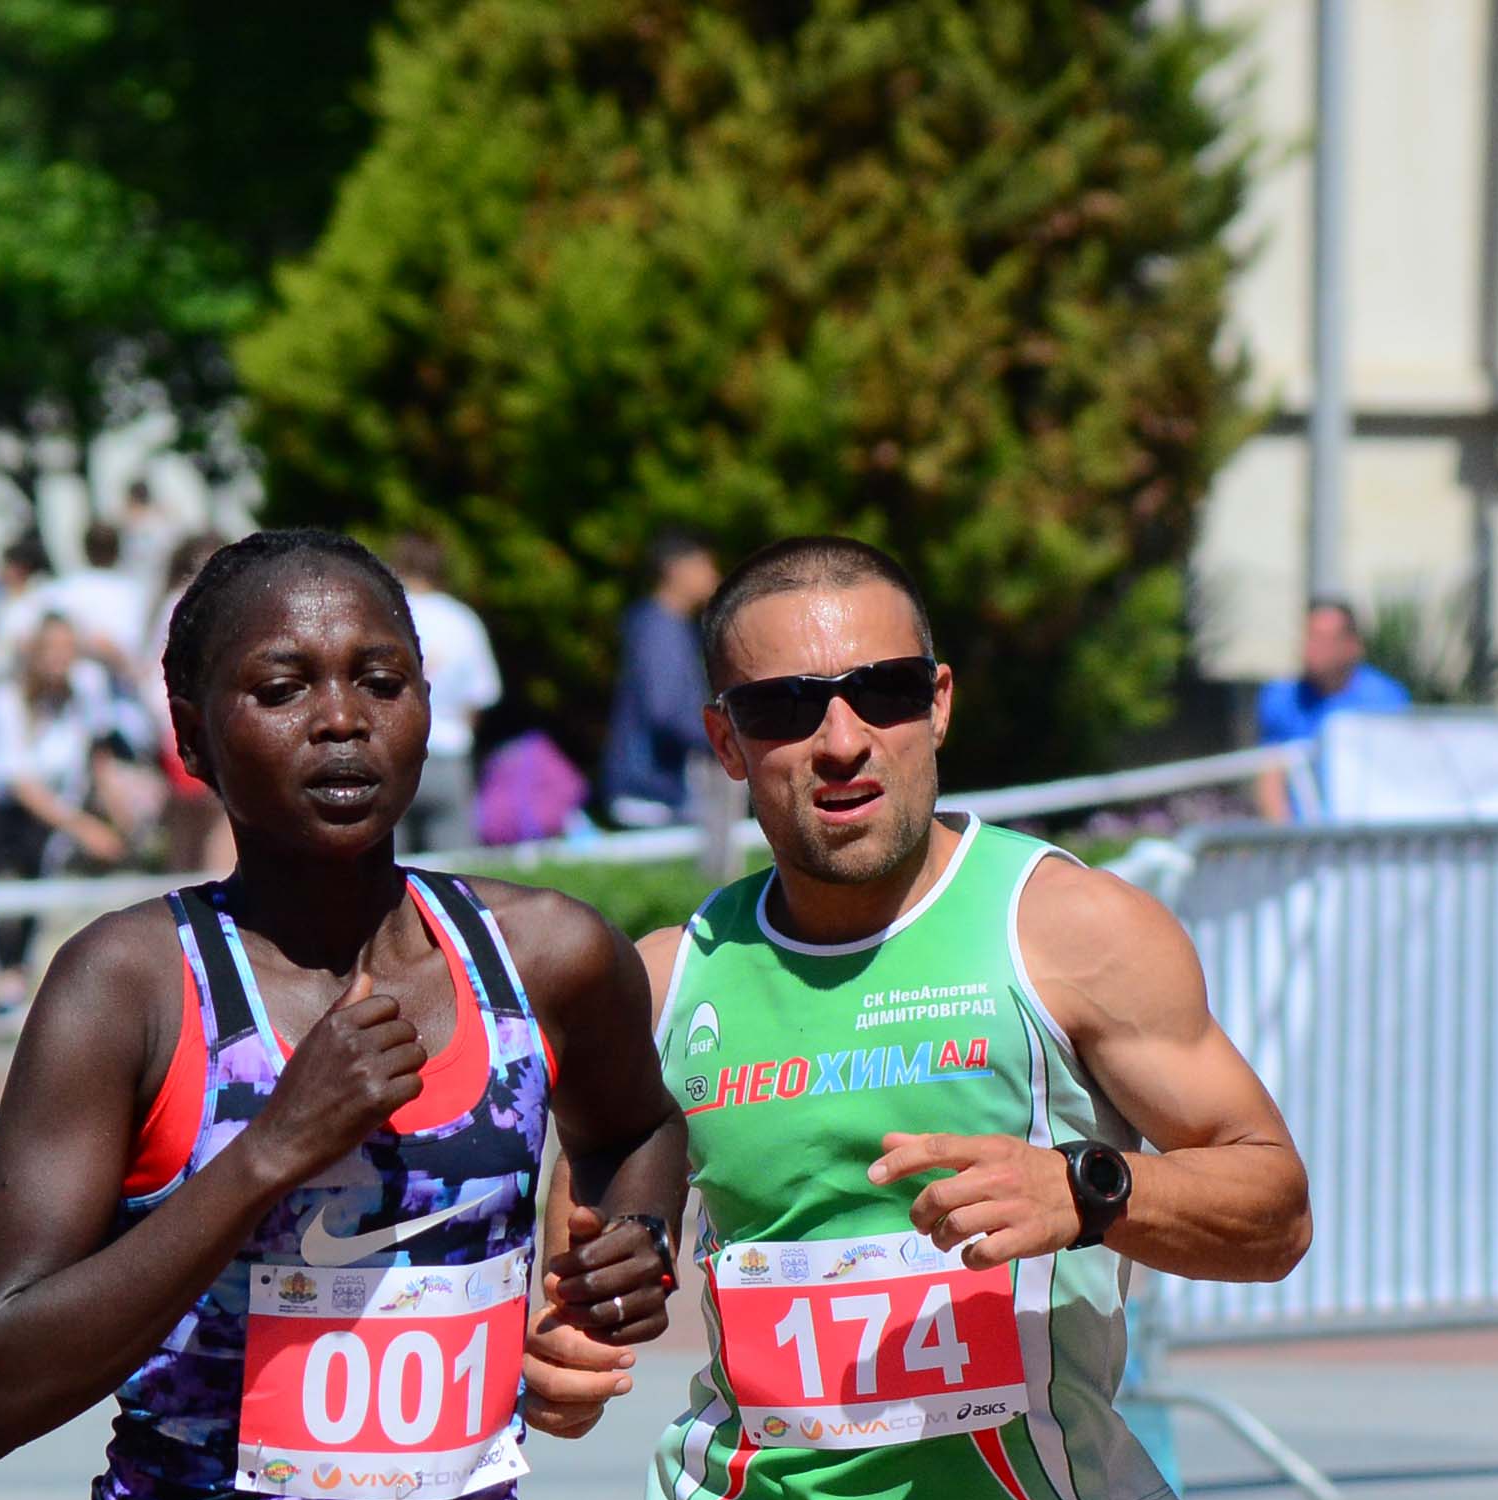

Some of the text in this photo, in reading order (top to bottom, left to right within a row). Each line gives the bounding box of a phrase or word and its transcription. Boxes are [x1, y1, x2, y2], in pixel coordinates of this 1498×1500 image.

[862, 983, 989, 1009] СК НеоАтлетик
[854, 998, 997, 1031] ДИМИТРОВГРАД
[937, 1037, 990, 1069] АД
[773, 1283, 971, 1399] 174
[302, 1321, 489, 1445] 001
[828, 1410, 950, 1437] VIVACOM
[973, 1402, 1007, 1417] asics
